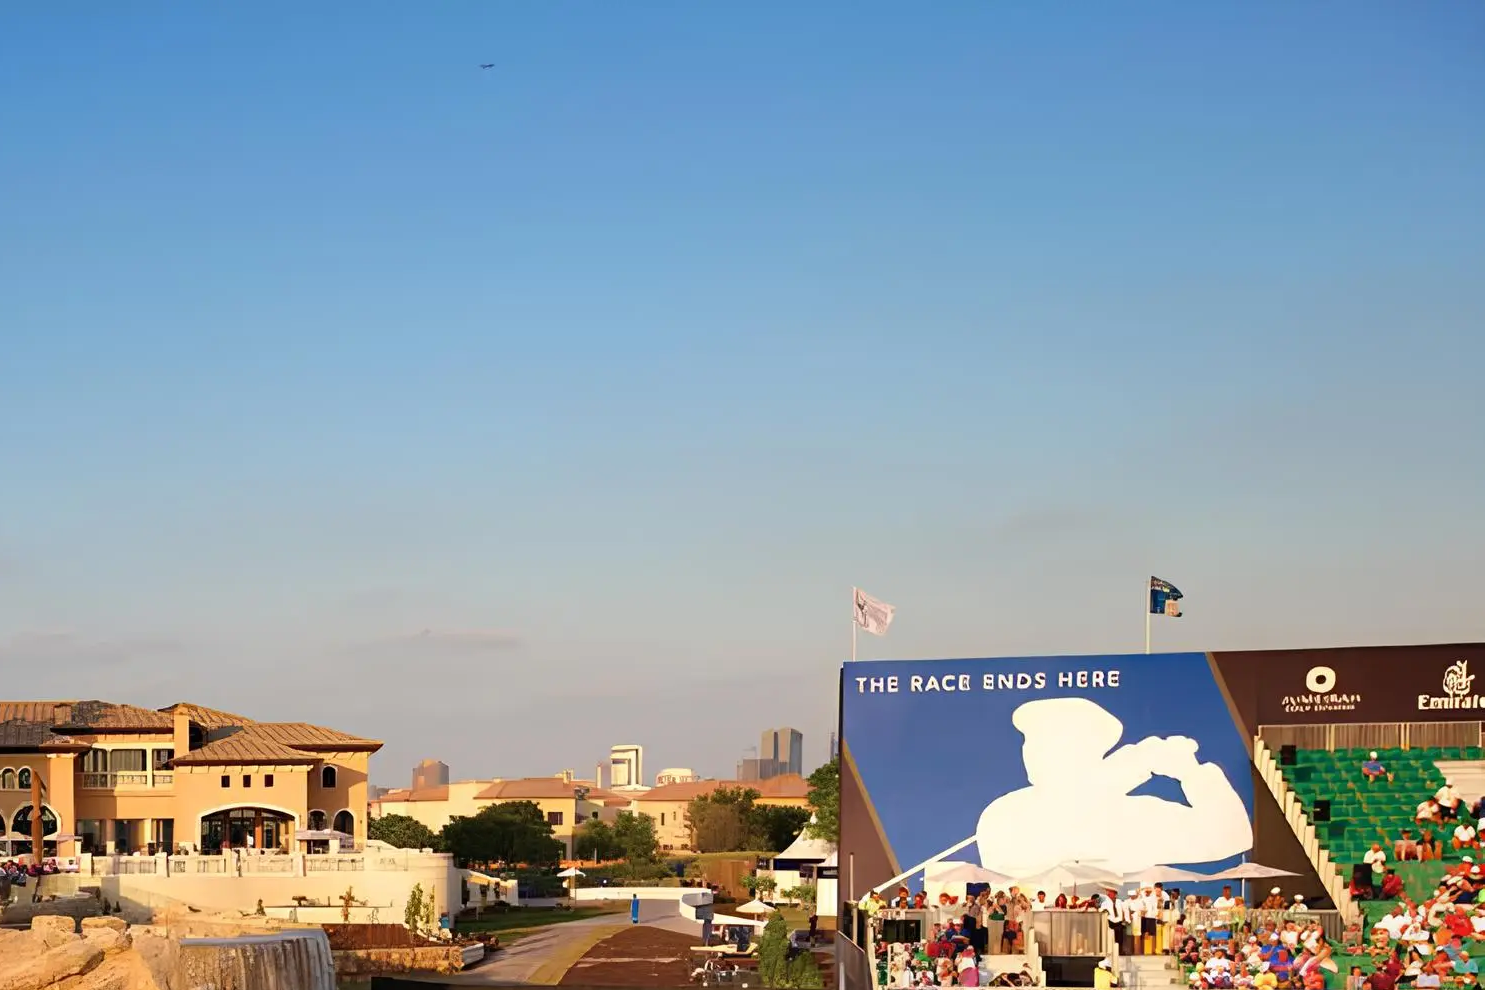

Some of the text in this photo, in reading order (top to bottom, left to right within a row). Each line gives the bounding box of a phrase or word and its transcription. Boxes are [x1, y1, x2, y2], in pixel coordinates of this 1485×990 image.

[855, 670, 1120, 693] THE RACE ENDS HERE
